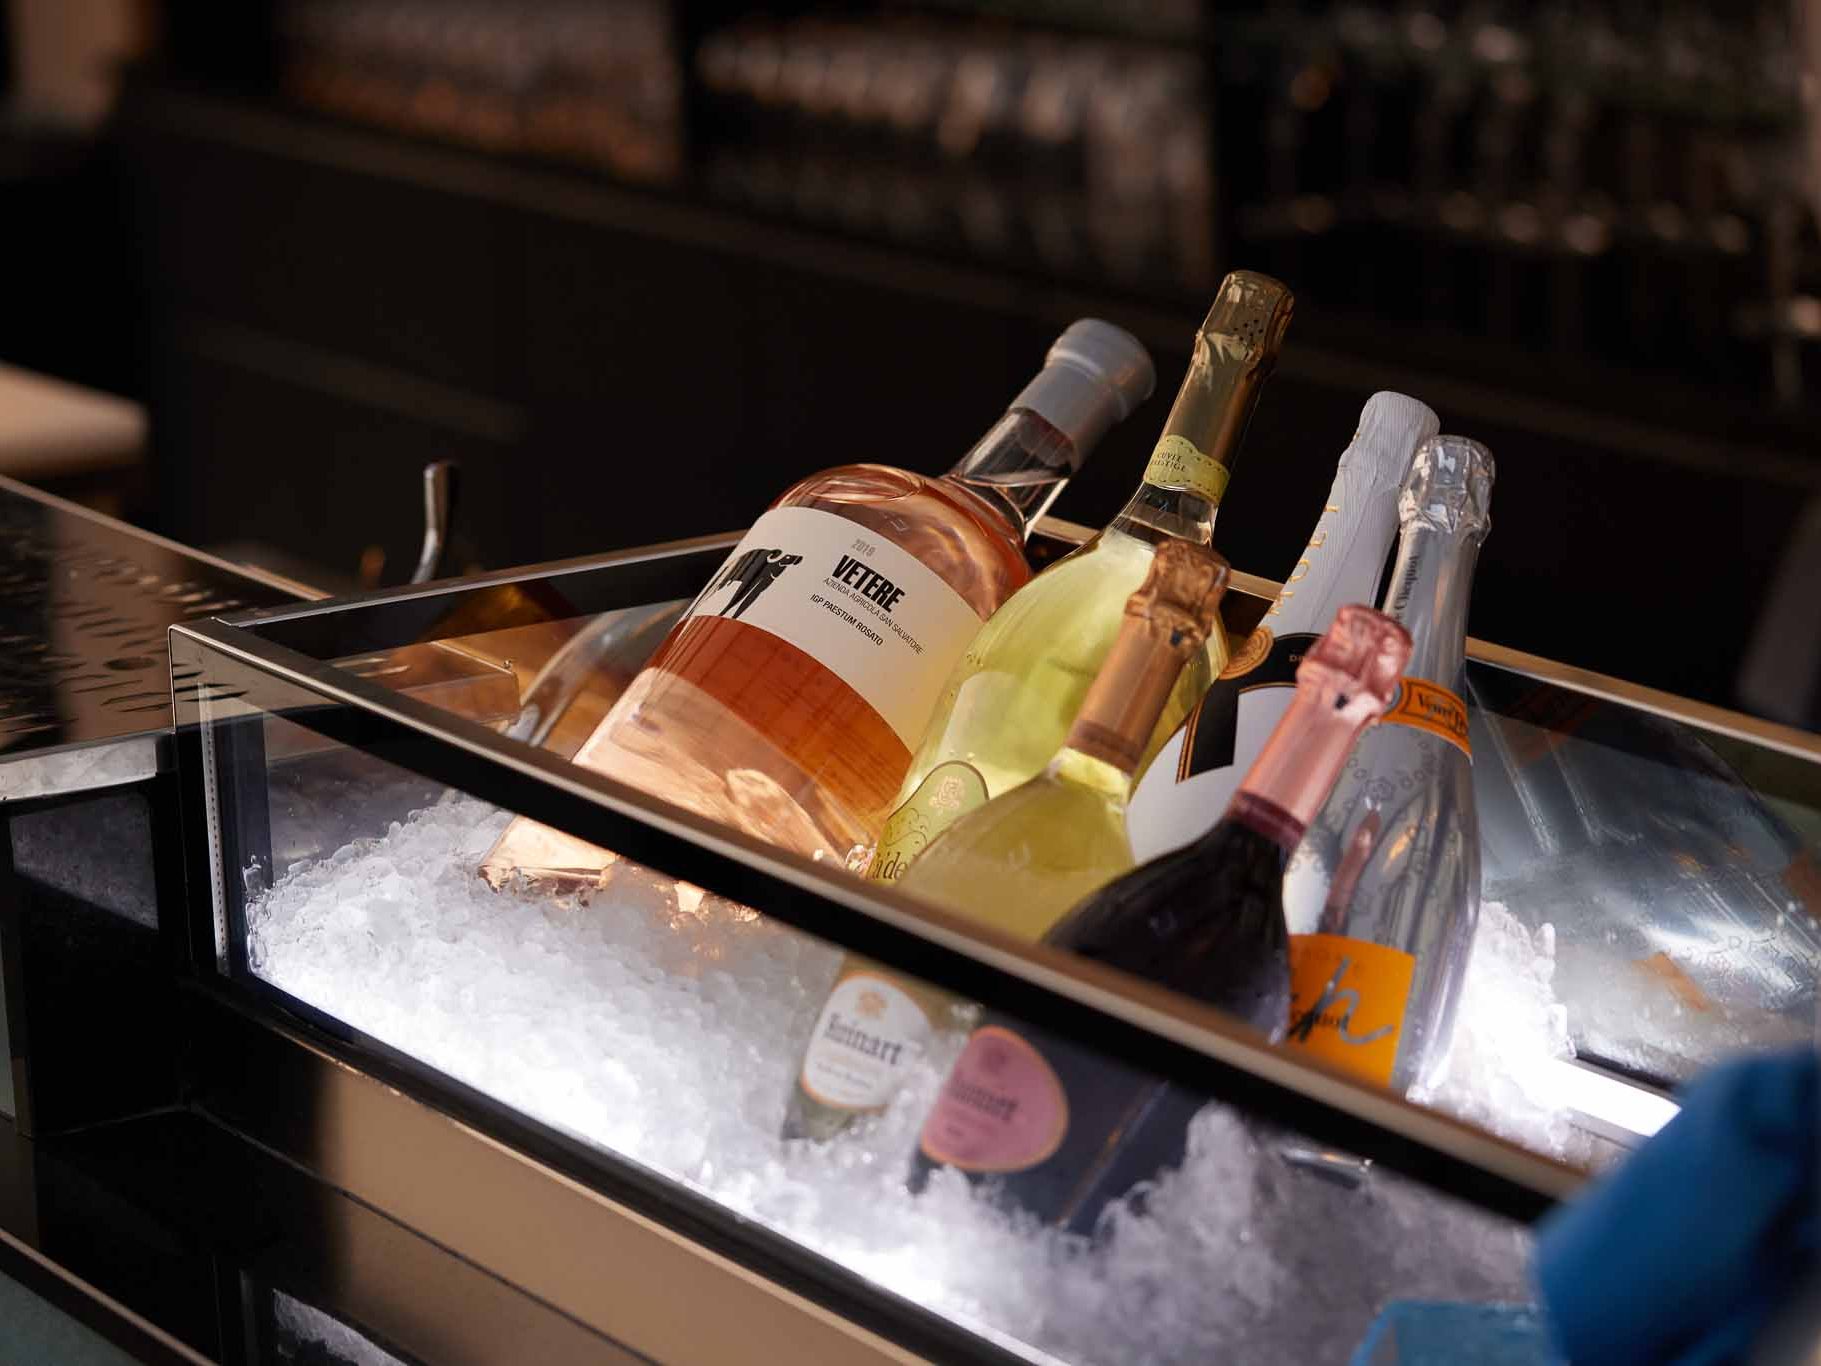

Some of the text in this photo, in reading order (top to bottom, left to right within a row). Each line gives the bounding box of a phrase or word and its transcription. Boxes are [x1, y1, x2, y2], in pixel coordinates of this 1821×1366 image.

[831, 554, 906, 614] VETERE
[810, 593, 885, 647] IGP PAESTUM ROSATO
[822, 577, 924, 656] AZIENDA AGRICOLA SAN SALVATORE
